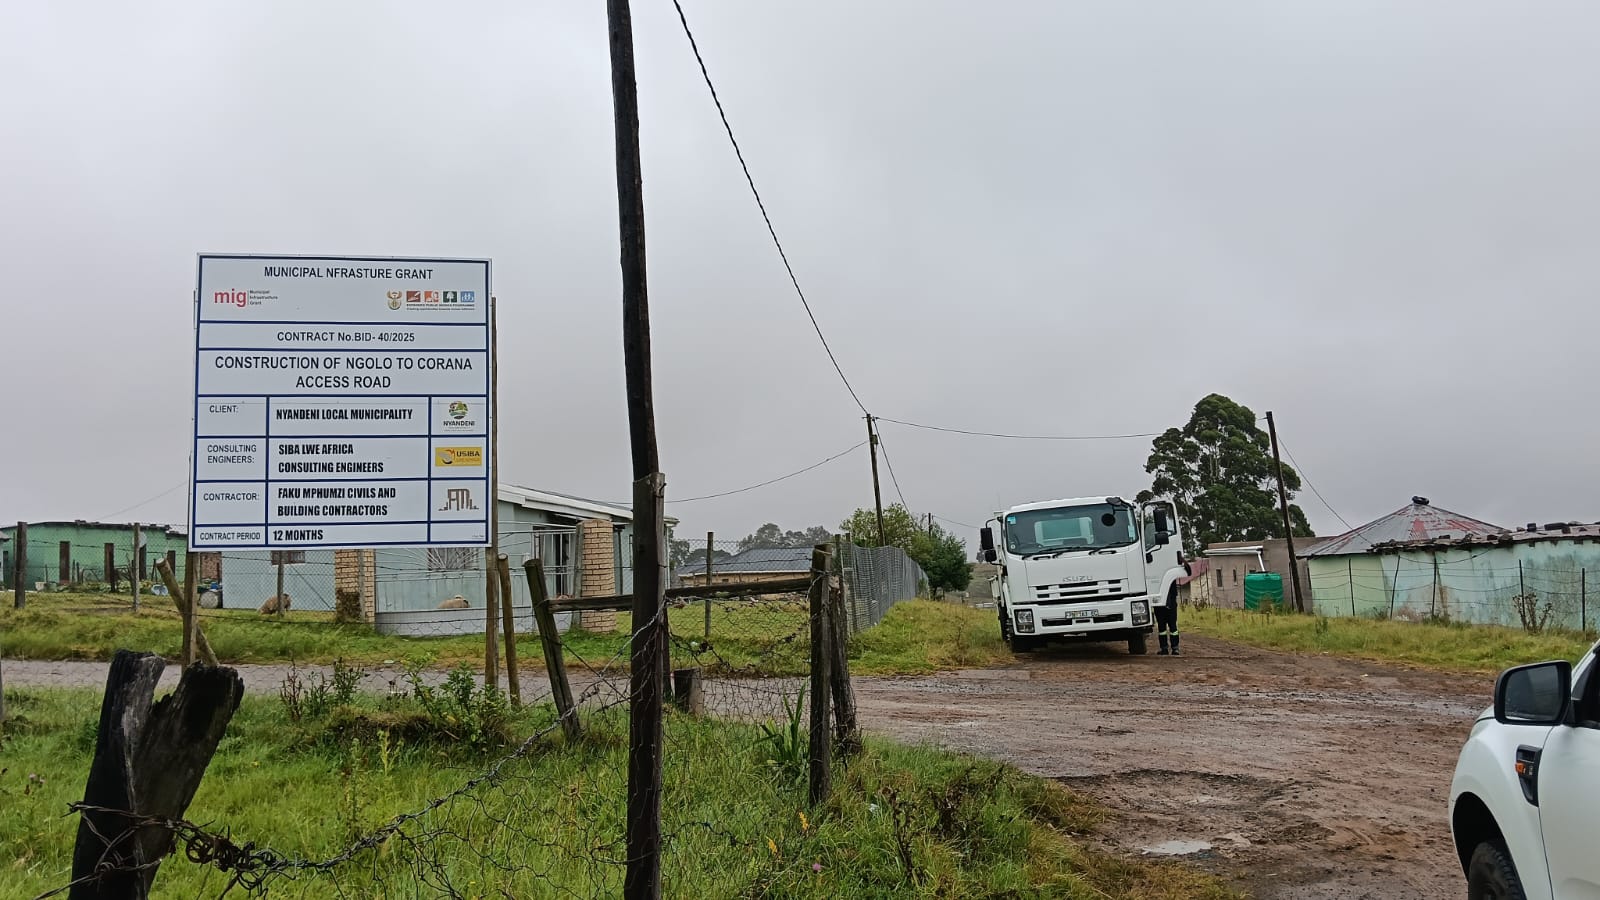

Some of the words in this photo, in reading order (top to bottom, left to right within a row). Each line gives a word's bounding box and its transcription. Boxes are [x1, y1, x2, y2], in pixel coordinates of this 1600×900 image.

[265, 267, 323, 277] MUNICIPAL
[327, 268, 392, 278] NFRASTURE
[396, 269, 433, 279] GRANT
[214, 288, 246, 308] mig
[278, 332, 334, 341] CONTRACT
[378, 333, 414, 341] 40/2025
[215, 356, 319, 369] CONSTRUCTION
[324, 357, 341, 369] OF
[347, 358, 392, 369] NGOLO
[396, 358, 413, 369] TO
[418, 358, 472, 369] CORANA
[296, 376, 349, 388] ACCESS
[354, 376, 390, 388] ROAD
[277, 409, 319, 419] NYANDENI
[322, 409, 348, 419] LOCAL
[351, 409, 412, 419] MUNICIPALITY
[279, 445, 300, 455] SIBA
[302, 444, 320, 454] LWE
[322, 444, 353, 454] AFRICA
[279, 462, 333, 472] CONSULTING
[336, 462, 383, 472] ENGINEERS
[278, 488, 300, 498] FAKU
[303, 488, 345, 498] MPHUMZI
[348, 488, 376, 498] CIVILS
[378, 488, 395, 498] AND
[278, 506, 320, 516] BUILDING
[322, 505, 387, 516] CONTRACTORS
[273, 530, 283, 540] 12
[285, 530, 323, 540] MONTHS
